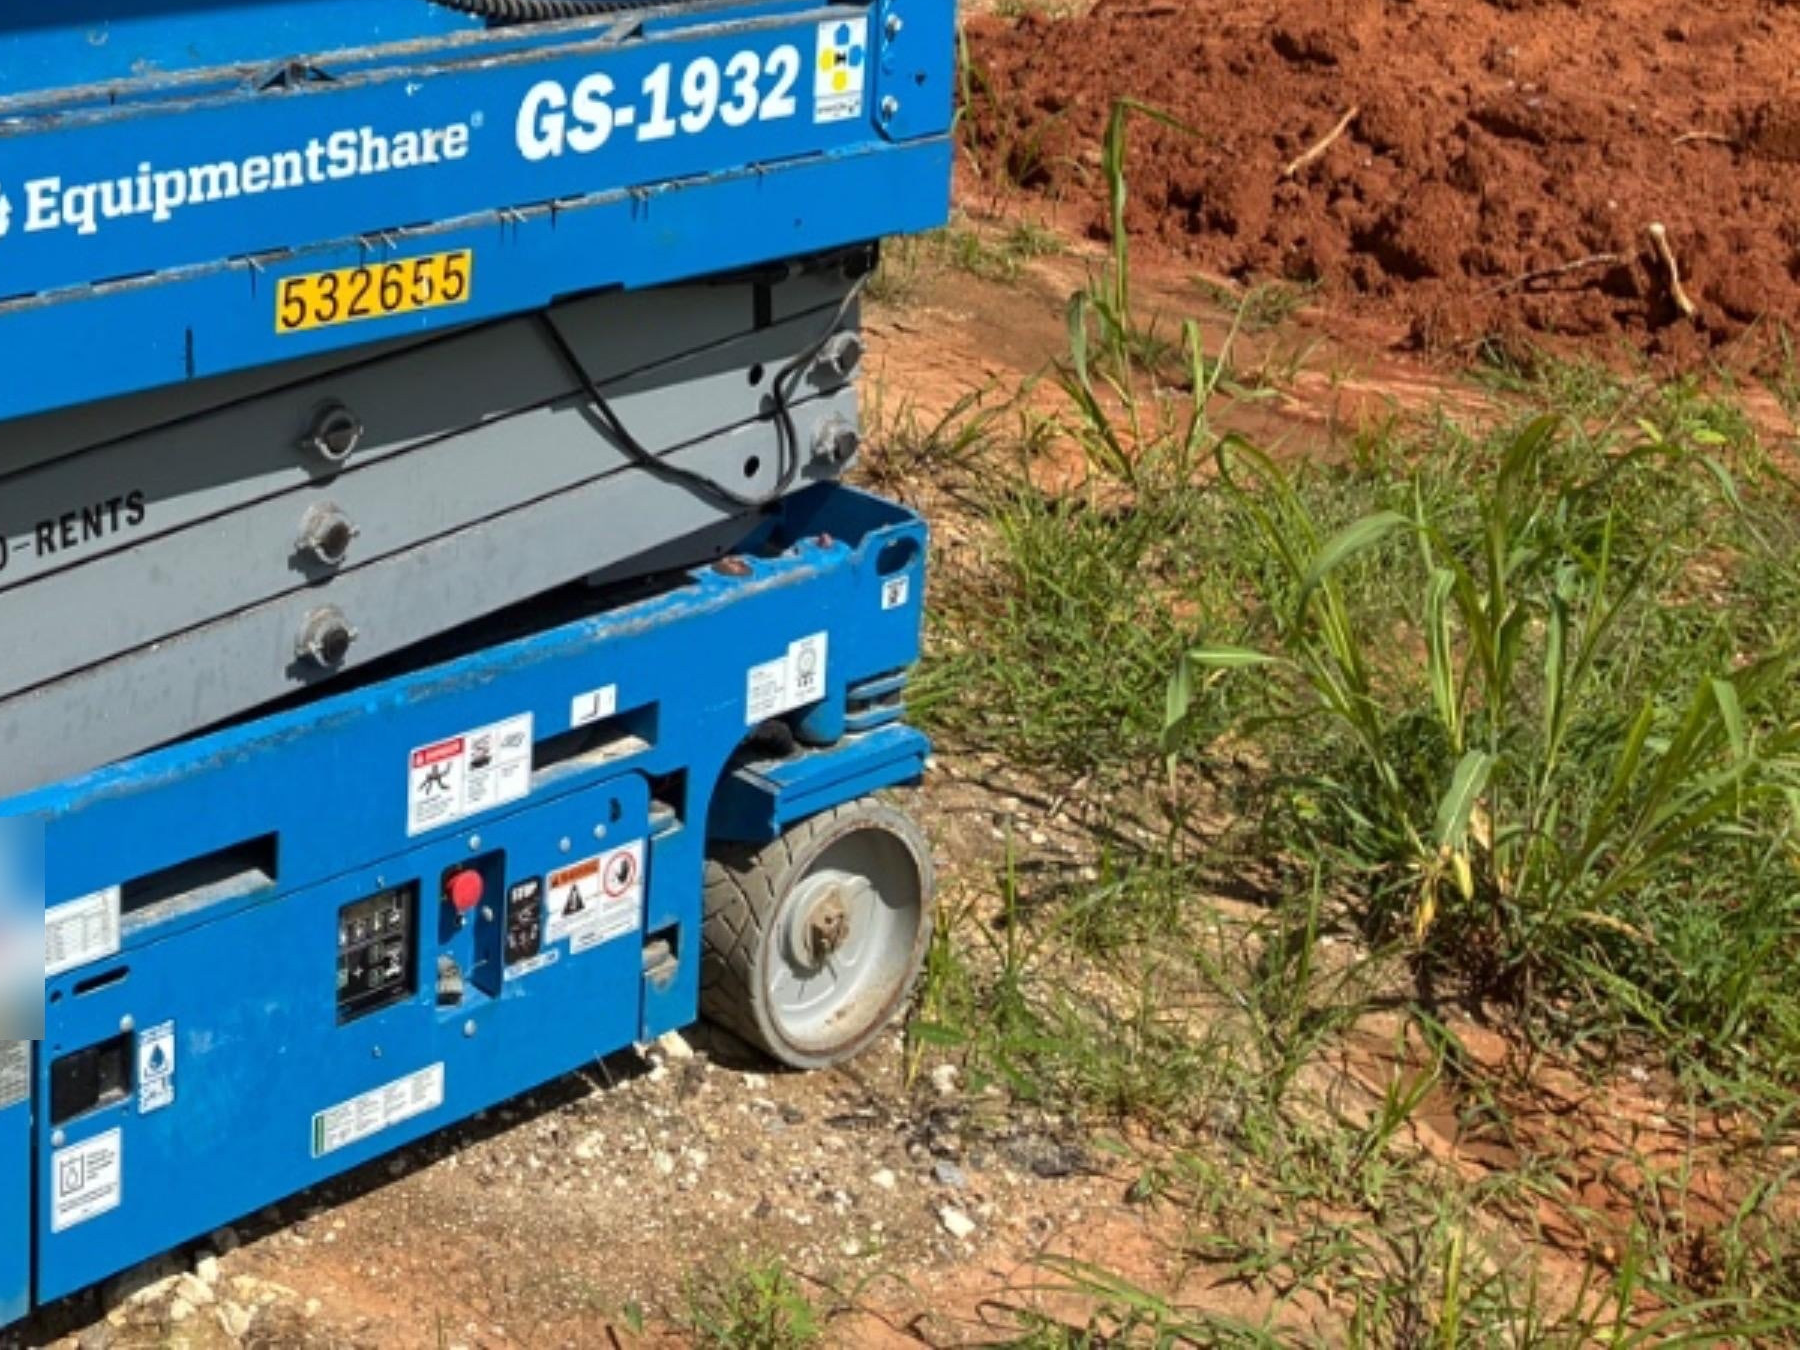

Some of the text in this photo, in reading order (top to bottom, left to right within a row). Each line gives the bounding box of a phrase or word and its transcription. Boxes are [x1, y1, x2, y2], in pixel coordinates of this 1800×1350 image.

[516, 44, 800, 161] GS-1932
[23, 121, 470, 236] EquipmentShare
[281, 253, 465, 329] 532655
